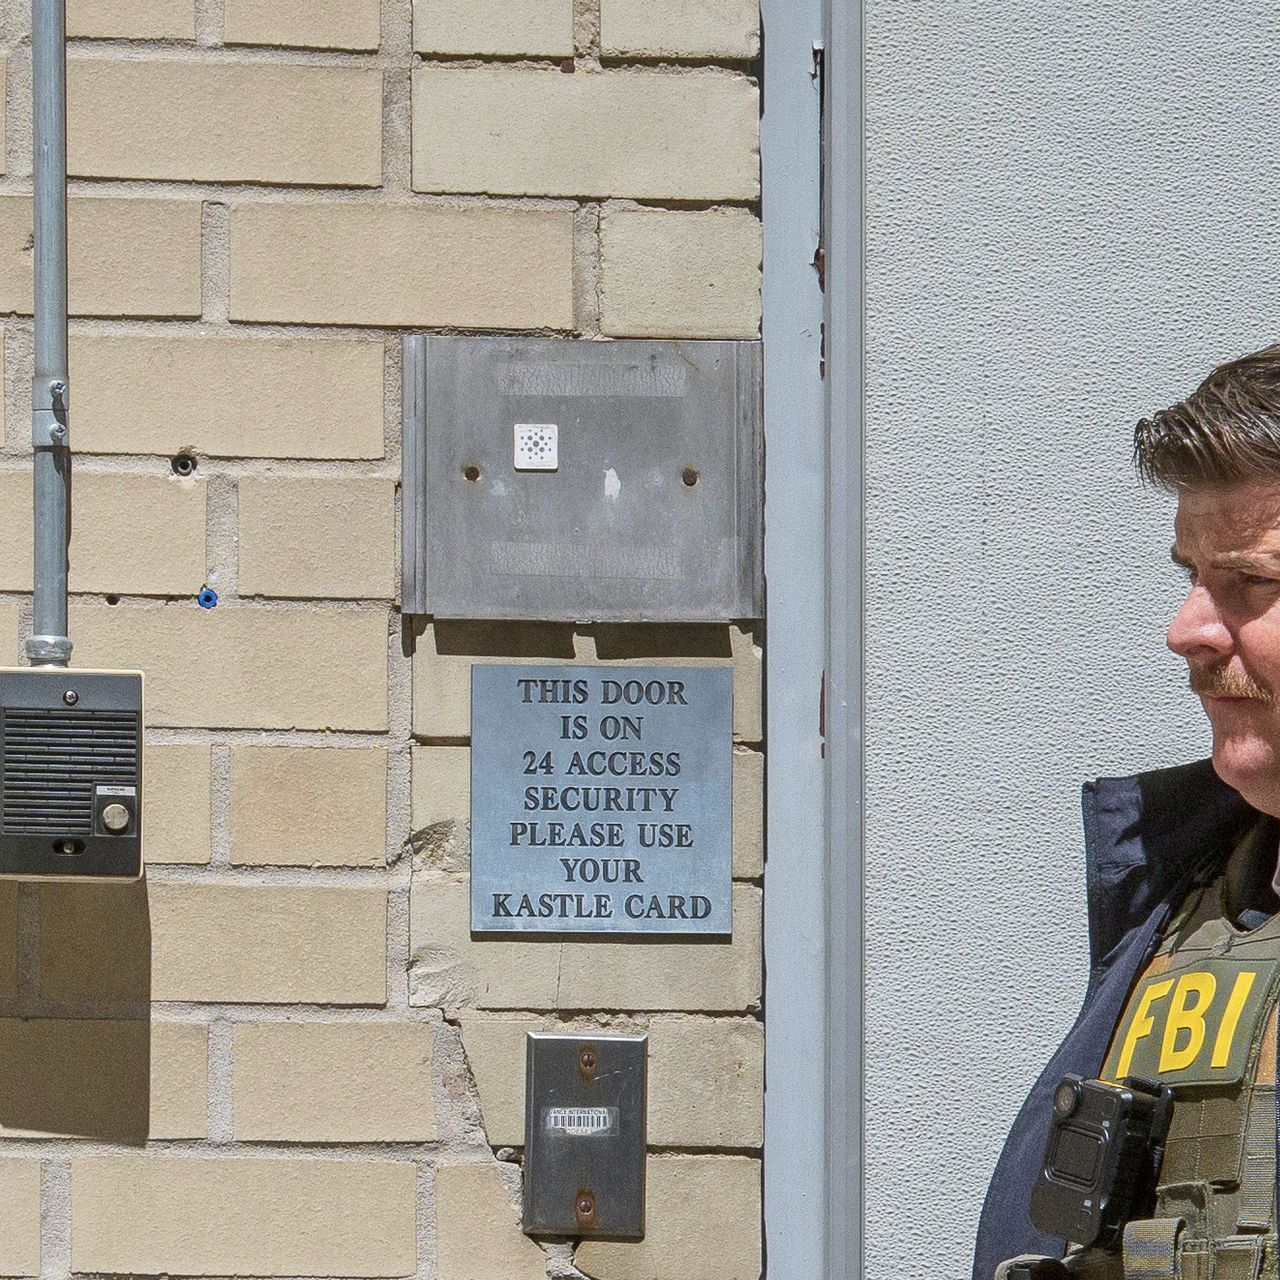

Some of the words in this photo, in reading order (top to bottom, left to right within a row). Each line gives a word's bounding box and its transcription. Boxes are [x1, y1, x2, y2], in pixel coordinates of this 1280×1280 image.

[517, 679, 589, 704] THIS
[601, 680, 689, 705] DOOR
[560, 715, 588, 740] IS
[600, 715, 644, 740] ON
[522, 751, 555, 775] 24
[565, 751, 682, 776] ACCESS
[523, 786, 680, 812] SECURITY
[509, 822, 625, 847] PLEASE
[638, 823, 695, 848] USE
[559, 858, 645, 883] YOUR
[491, 893, 613, 919] KASTLE
[624, 894, 712, 919] CARD
[1116, 971, 1256, 1078] FBI
